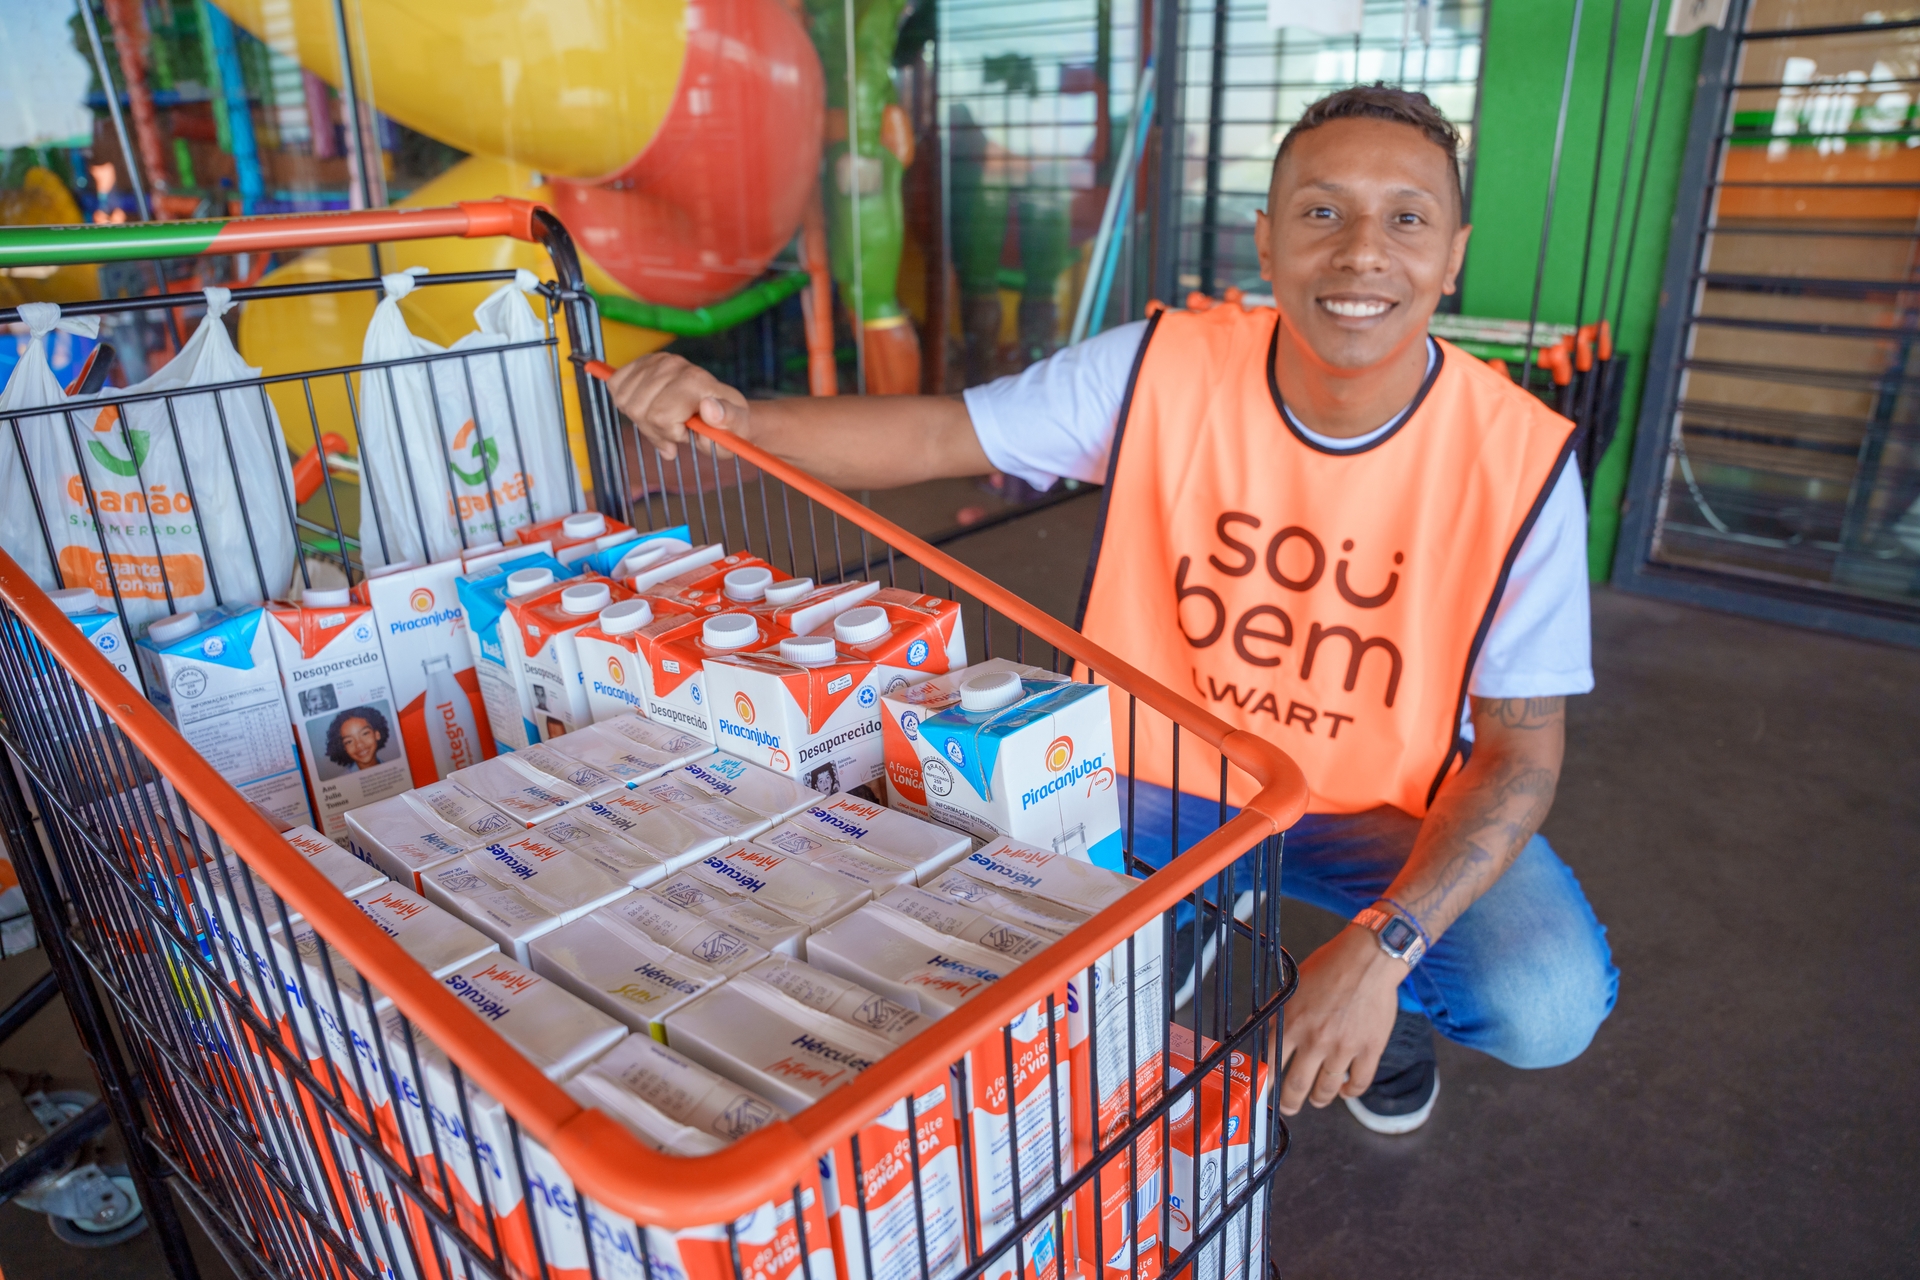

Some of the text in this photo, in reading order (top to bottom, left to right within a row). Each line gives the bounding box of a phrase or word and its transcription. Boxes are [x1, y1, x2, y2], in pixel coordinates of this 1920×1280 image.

[390, 608, 462, 635] Piracanjuba
[1175, 556, 1403, 708] bem
[292, 653, 379, 682] Desaparecido
[594, 681, 641, 707] Piracanjuba
[651, 703, 708, 730] Desaparecido
[719, 719, 780, 748] Piracanjuba
[799, 720, 882, 764] Desaparecido
[685, 764, 737, 795] Hércules
[889, 761, 919, 778] A força
[893, 773, 925, 790] LONGA
[927, 764, 946, 775] BRASIL
[1022, 756, 1102, 811] Piracanjuba
[523, 786, 569, 807] Hércules
[827, 799, 887, 820] Integral
[585, 801, 637, 831] Hércules
[806, 806, 868, 839] Hércules
[935, 801, 969, 818] INFORMAÇÃO
[970, 814, 1000, 836] NUTRICIONAL
[486, 843, 538, 881] Hércules
[725, 847, 787, 871] Integral
[991, 844, 1057, 868] Integral
[703, 856, 766, 893] Hércules
[968, 853, 1042, 889] Hércules
[634, 963, 701, 994] Hércules
[927, 955, 1000, 981] Hércule
[445, 974, 511, 1021] Hércules
[607, 983, 661, 1005] Semi
[985, 1085, 993, 1099] A
[1020, 1050, 1033, 1067] do
[1034, 1033, 1060, 1055] leie
[992, 1070, 1027, 1108] LOGA
[894, 1137, 911, 1157] do
